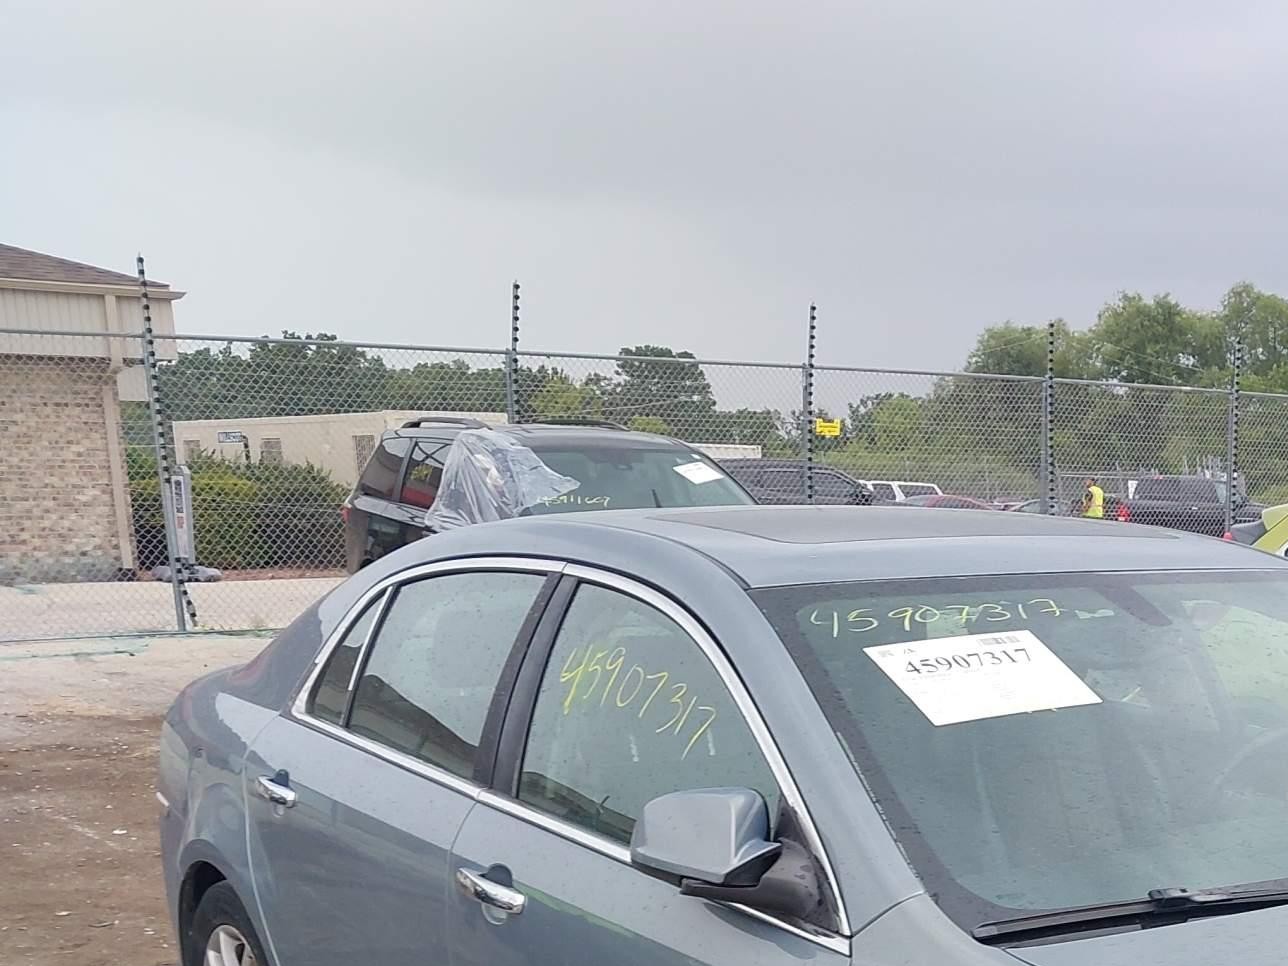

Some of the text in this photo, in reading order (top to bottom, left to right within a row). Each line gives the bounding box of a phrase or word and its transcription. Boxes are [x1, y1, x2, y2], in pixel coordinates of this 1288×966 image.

[809, 598, 1066, 638] 45907317
[905, 647, 1033, 675] 45907317
[559, 645, 717, 761] 45907317
